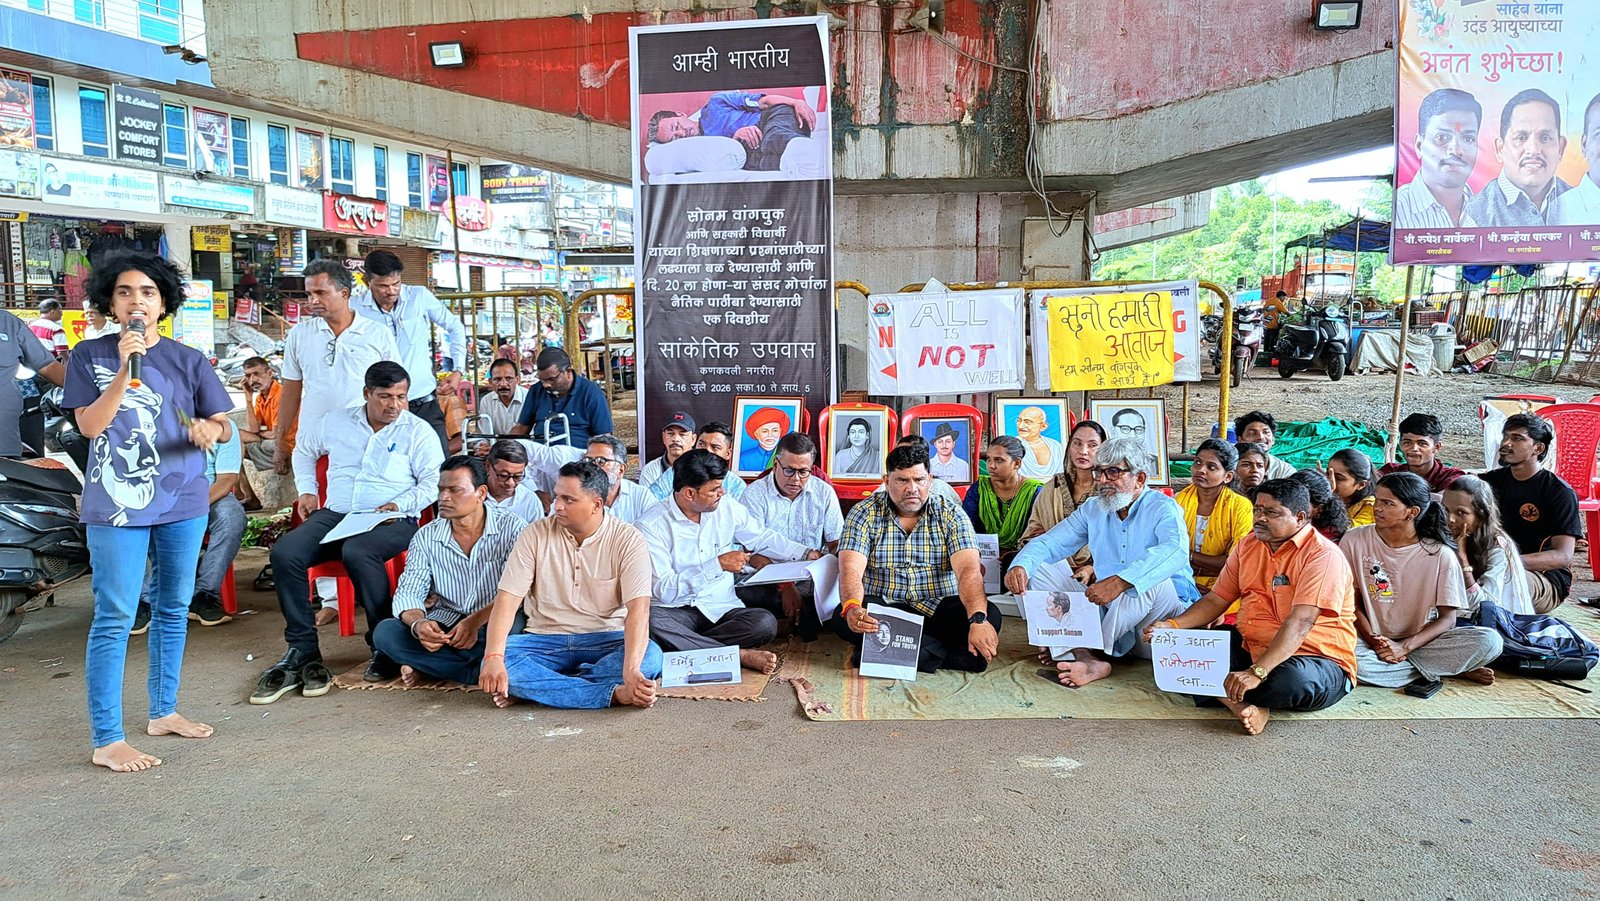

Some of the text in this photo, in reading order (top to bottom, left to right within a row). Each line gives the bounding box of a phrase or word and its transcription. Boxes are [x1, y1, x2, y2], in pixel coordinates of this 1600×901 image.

[1463, 15, 1563, 39] उदंड आयुष्याच्या
[672, 42, 790, 73] आम्ही भारतीय
[1420, 45, 1471, 74] अनंत
[120, 116, 157, 131] JOCKEY
[118, 130, 160, 146] COMFORT
[123, 144, 157, 159] STORES
[483, 175, 548, 189] BODY TEMPLE
[687, 204, 785, 226] सोनम वांगचुक
[686, 225, 787, 240] आणि सहकारी विद्यार्थी
[1532, 231, 1563, 242] पारकर
[648, 241, 826, 258] यांच्या शिक्षणाच्या प्रश्नांसाठीच्या
[705, 262, 725, 274] बळ
[727, 259, 782, 273] देण्यासाठी
[786, 259, 816, 272] आणि
[646, 278, 661, 292] दि.
[664, 280, 680, 291] 20
[683, 280, 698, 291] ला
[751, 276, 782, 291] संसद
[784, 275, 828, 290] मोर्चाला
[670, 294, 704, 309] नैतिक
[749, 293, 803, 308] देण्यासाठी
[703, 311, 770, 326] एक दिवशीय
[910, 300, 989, 328] ALL
[1059, 296, 1107, 340] सुनो
[1108, 292, 1164, 329] हमारी
[943, 328, 960, 340] IS
[658, 336, 816, 360] सांकेतिक उपवास
[1104, 329, 1174, 366] आवाज
[918, 344, 996, 369] NOT
[699, 365, 776, 376] कणकवली नगरीत
[1110, 361, 1144, 377] वांगचुक
[964, 369, 1019, 385] WELL
[1096, 374, 1105, 386] के
[690, 382, 707, 395] जुलै
[711, 384, 731, 393] 2026
[770, 381, 777, 393] ते
[804, 384, 811, 393] 5
[895, 634, 914, 644] STAND
[1041, 628, 1063, 636] support
[1064, 628, 1083, 637] Sonam
[901, 642, 917, 650] TRUTH
[1184, 636, 1223, 648] प्रधान
